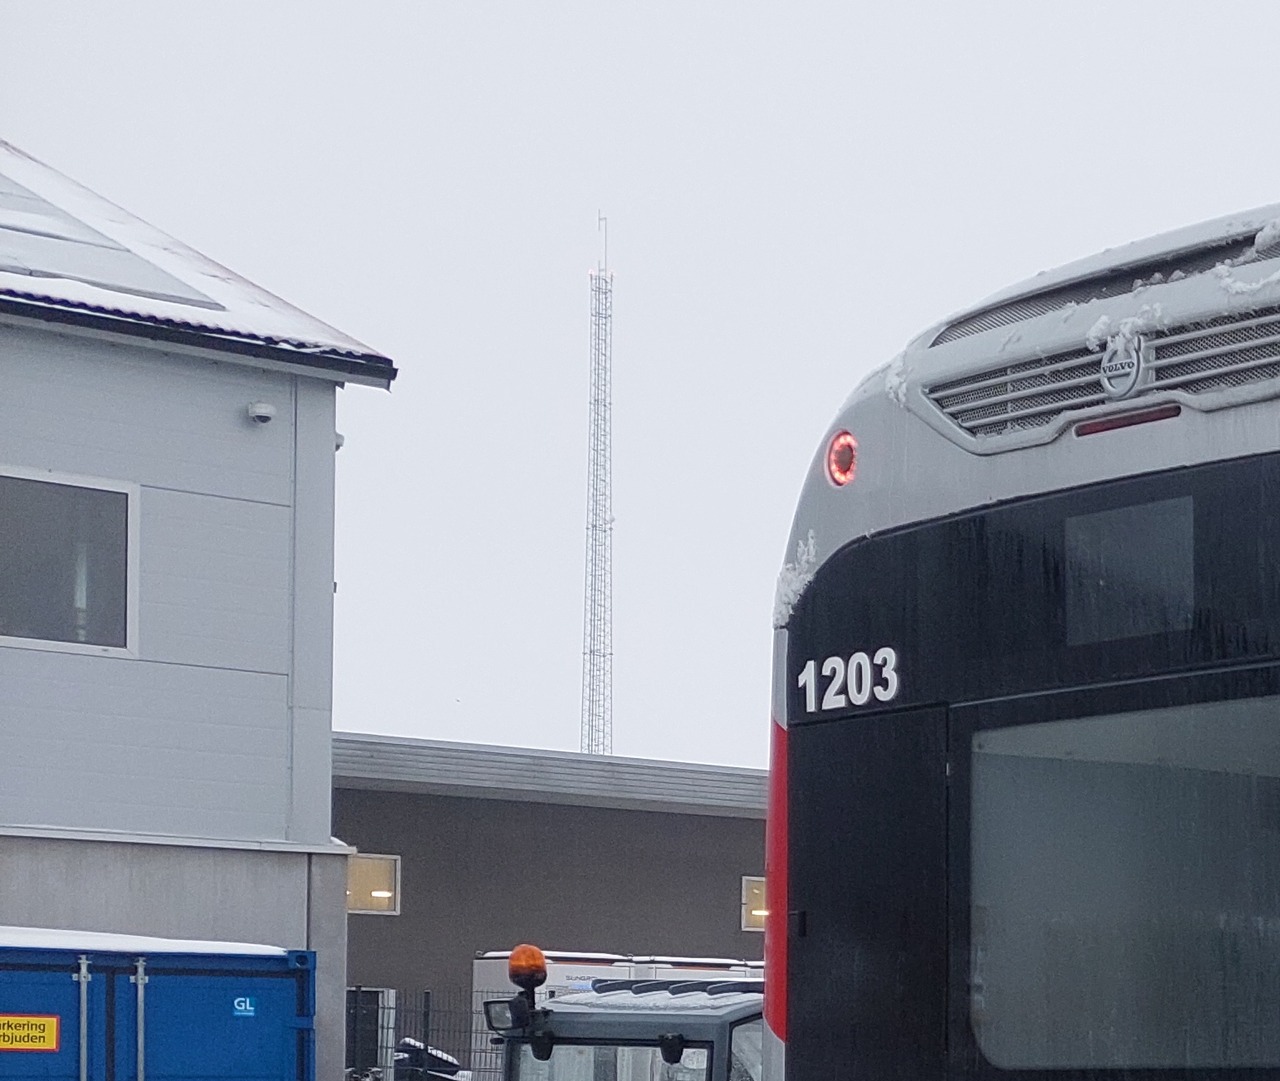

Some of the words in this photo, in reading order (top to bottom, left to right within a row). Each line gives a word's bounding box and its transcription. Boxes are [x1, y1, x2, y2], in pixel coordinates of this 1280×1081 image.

[1102, 361, 1135, 374] VOLVO
[798, 647, 898, 713] 1203
[233, 997, 254, 1010] GL
[0, 1020, 46, 1033] rkering
